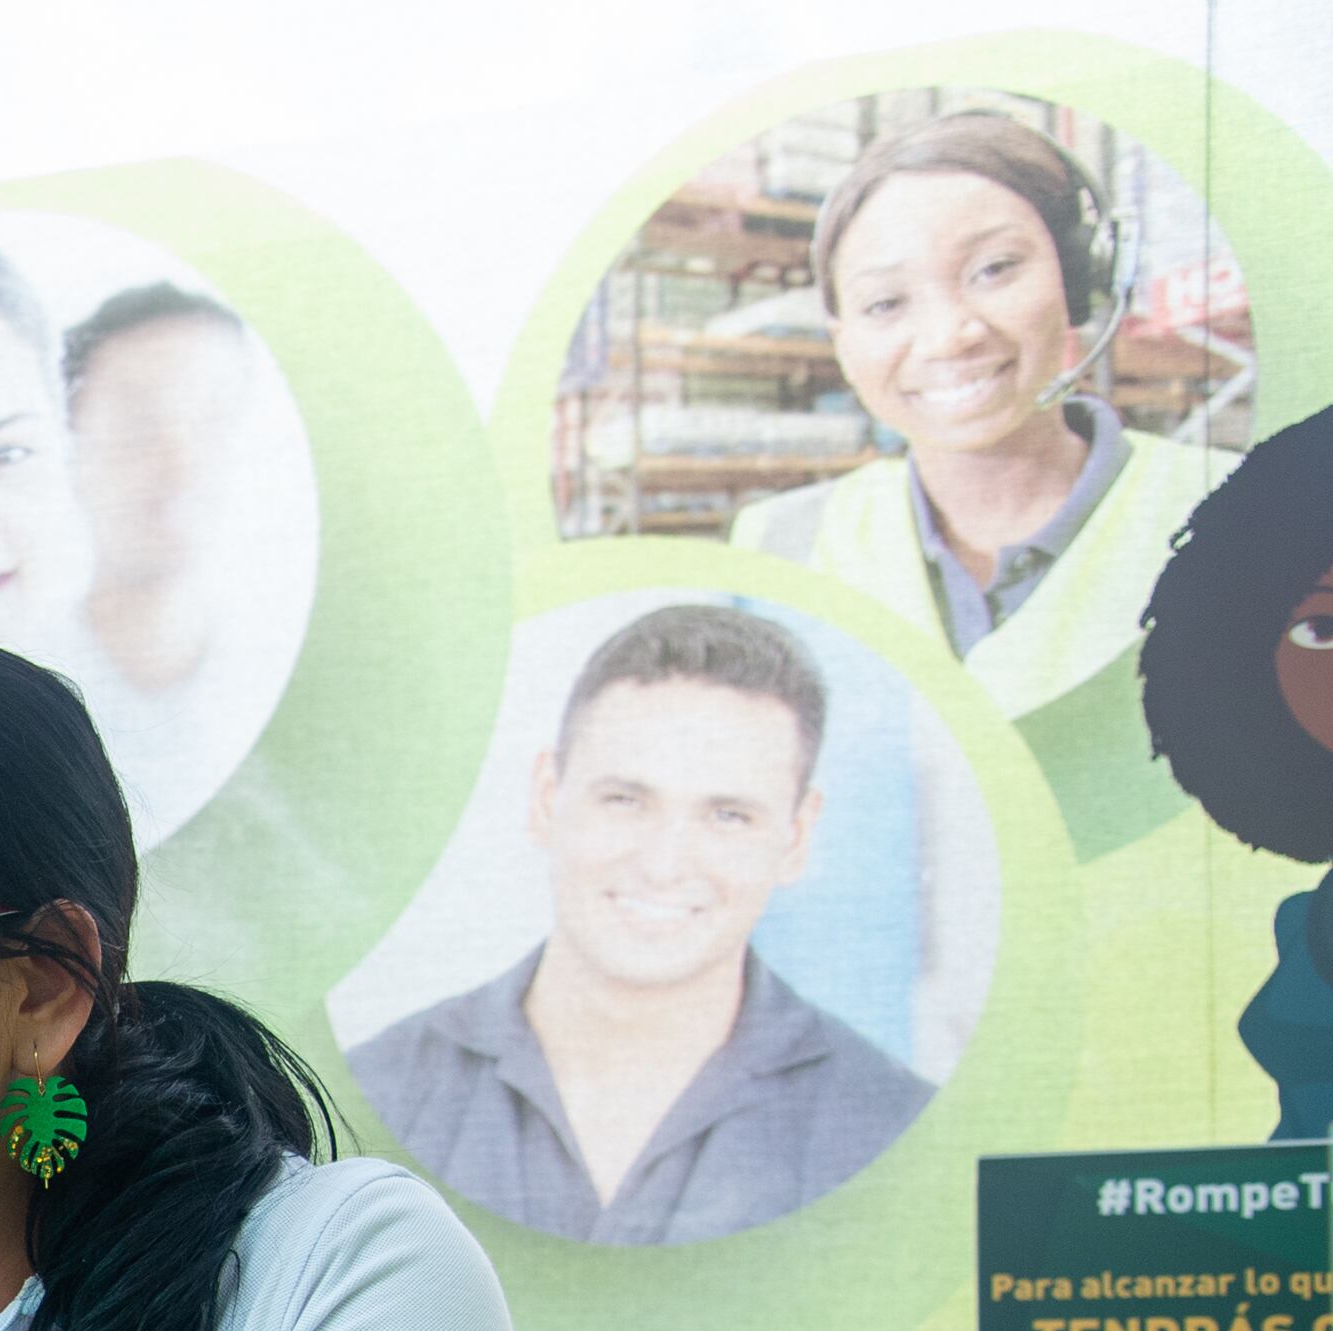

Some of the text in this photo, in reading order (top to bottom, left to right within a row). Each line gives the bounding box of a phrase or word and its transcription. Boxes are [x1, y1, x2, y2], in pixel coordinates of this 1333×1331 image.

[990, 1273, 1073, 1301] Para
[1080, 1270, 1235, 1299] alcanzar
[1244, 1268, 1280, 1296] lo
